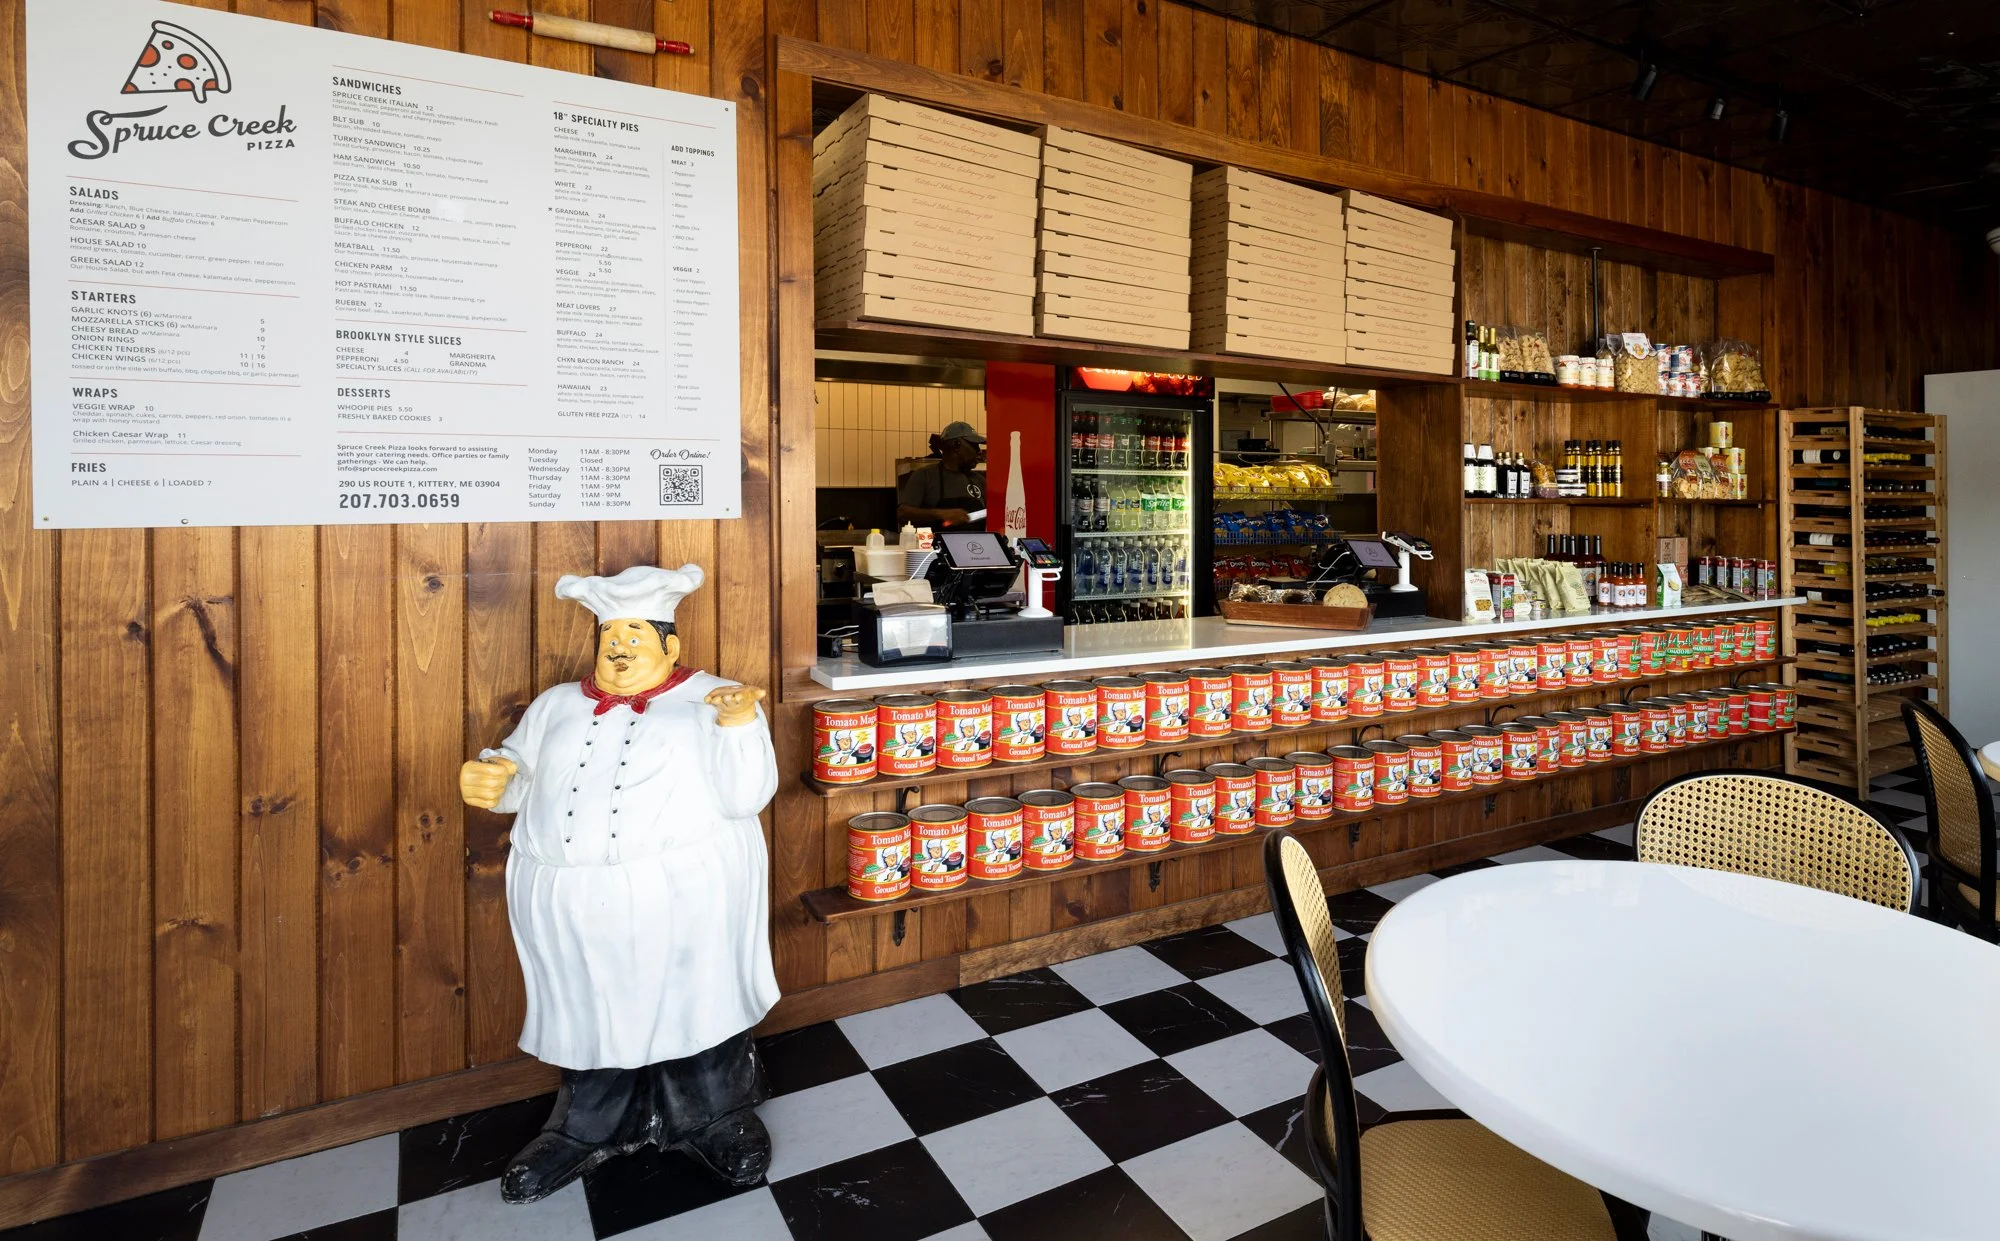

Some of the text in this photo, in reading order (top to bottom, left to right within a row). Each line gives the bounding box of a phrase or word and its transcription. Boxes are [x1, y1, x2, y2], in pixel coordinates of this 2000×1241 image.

[332, 77, 402, 95] SANDWICHES
[332, 90, 362, 100] SPRUCE
[364, 96, 388, 104] CREEK
[389, 100, 419, 109] ITALIAN
[553, 111, 639, 132] 18" SPECIALTY PIES
[68, 104, 298, 160] Spruce Creek
[554, 126, 578, 135] CHEESE
[247, 138, 295, 151] PIZZA
[333, 134, 363, 143] TURKEY
[364, 139, 406, 149] SANDWICH
[554, 147, 597, 157] MARGHERITA
[685, 147, 715, 157] TOPPINGS
[70, 186, 119, 200] SALADS
[70, 217, 106, 226] CAESAR
[108, 221, 137, 229] SALAD
[334, 217, 370, 226] BUFFALO
[371, 221, 404, 229] CHICKEN
[70, 237, 102, 245] HOUSE
[105, 240, 134, 248] SALAD
[334, 242, 375, 251] MEATBALL
[555, 241, 592, 250] PEPPERONI
[354, 282, 392, 290] PASTRAMI
[71, 291, 136, 304] STARTERS
[71, 306, 104, 314] GARLIC
[108, 308, 138, 316] KNOTS
[336, 330, 462, 346] BROOKLYN STYLE SLICES
[72, 387, 118, 398] WRAPS
[337, 388, 391, 398] DESSERTS
[650, 448, 711, 460] Order Online!
[72, 462, 106, 472] FRIES
[340, 494, 460, 508] 207.703.0659
[1103, 690, 1131, 700] Tomato
[891, 709, 923, 720] Tomato
[949, 705, 980, 715] Tomato
[824, 716, 858, 726] Tomato
[952, 755, 975, 763] Ground
[894, 761, 918, 769] Ground
[828, 768, 852, 776] Ground
[1299, 768, 1324, 776] Tomato
[918, 825, 949, 836] Tomato
[871, 834, 902, 845] Tomato
[920, 875, 944, 884] Ground
